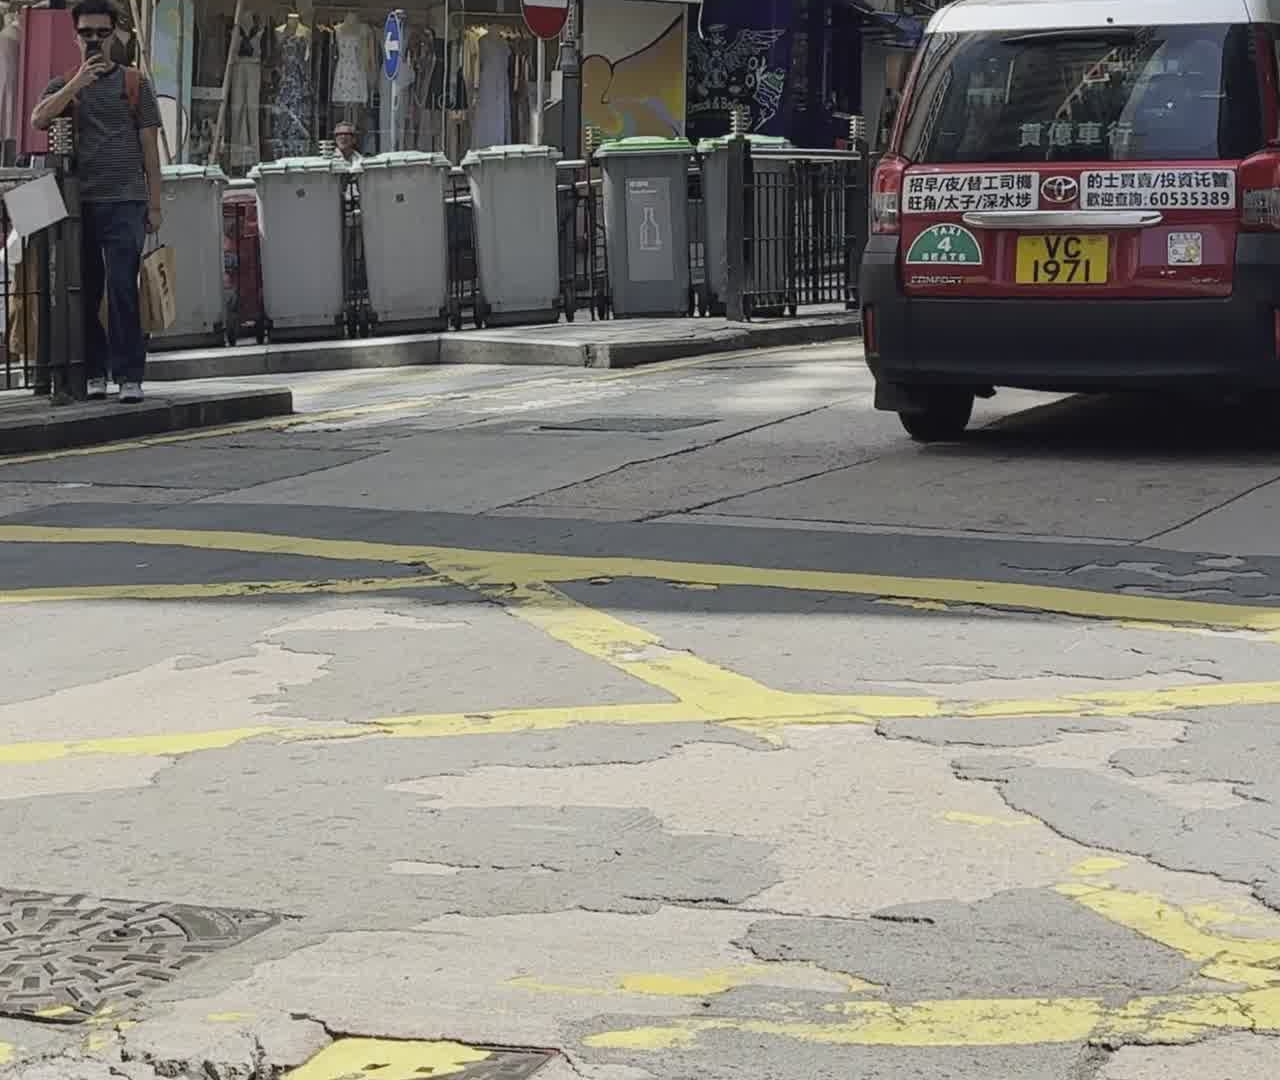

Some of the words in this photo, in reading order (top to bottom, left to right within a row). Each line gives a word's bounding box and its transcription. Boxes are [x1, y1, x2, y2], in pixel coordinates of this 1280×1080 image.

[908, 192, 1032, 211] 旺角/太子/深水埗
[937, 237, 953, 252] 4
[1044, 236, 1082, 259] VC
[1033, 260, 1091, 283] 1971
